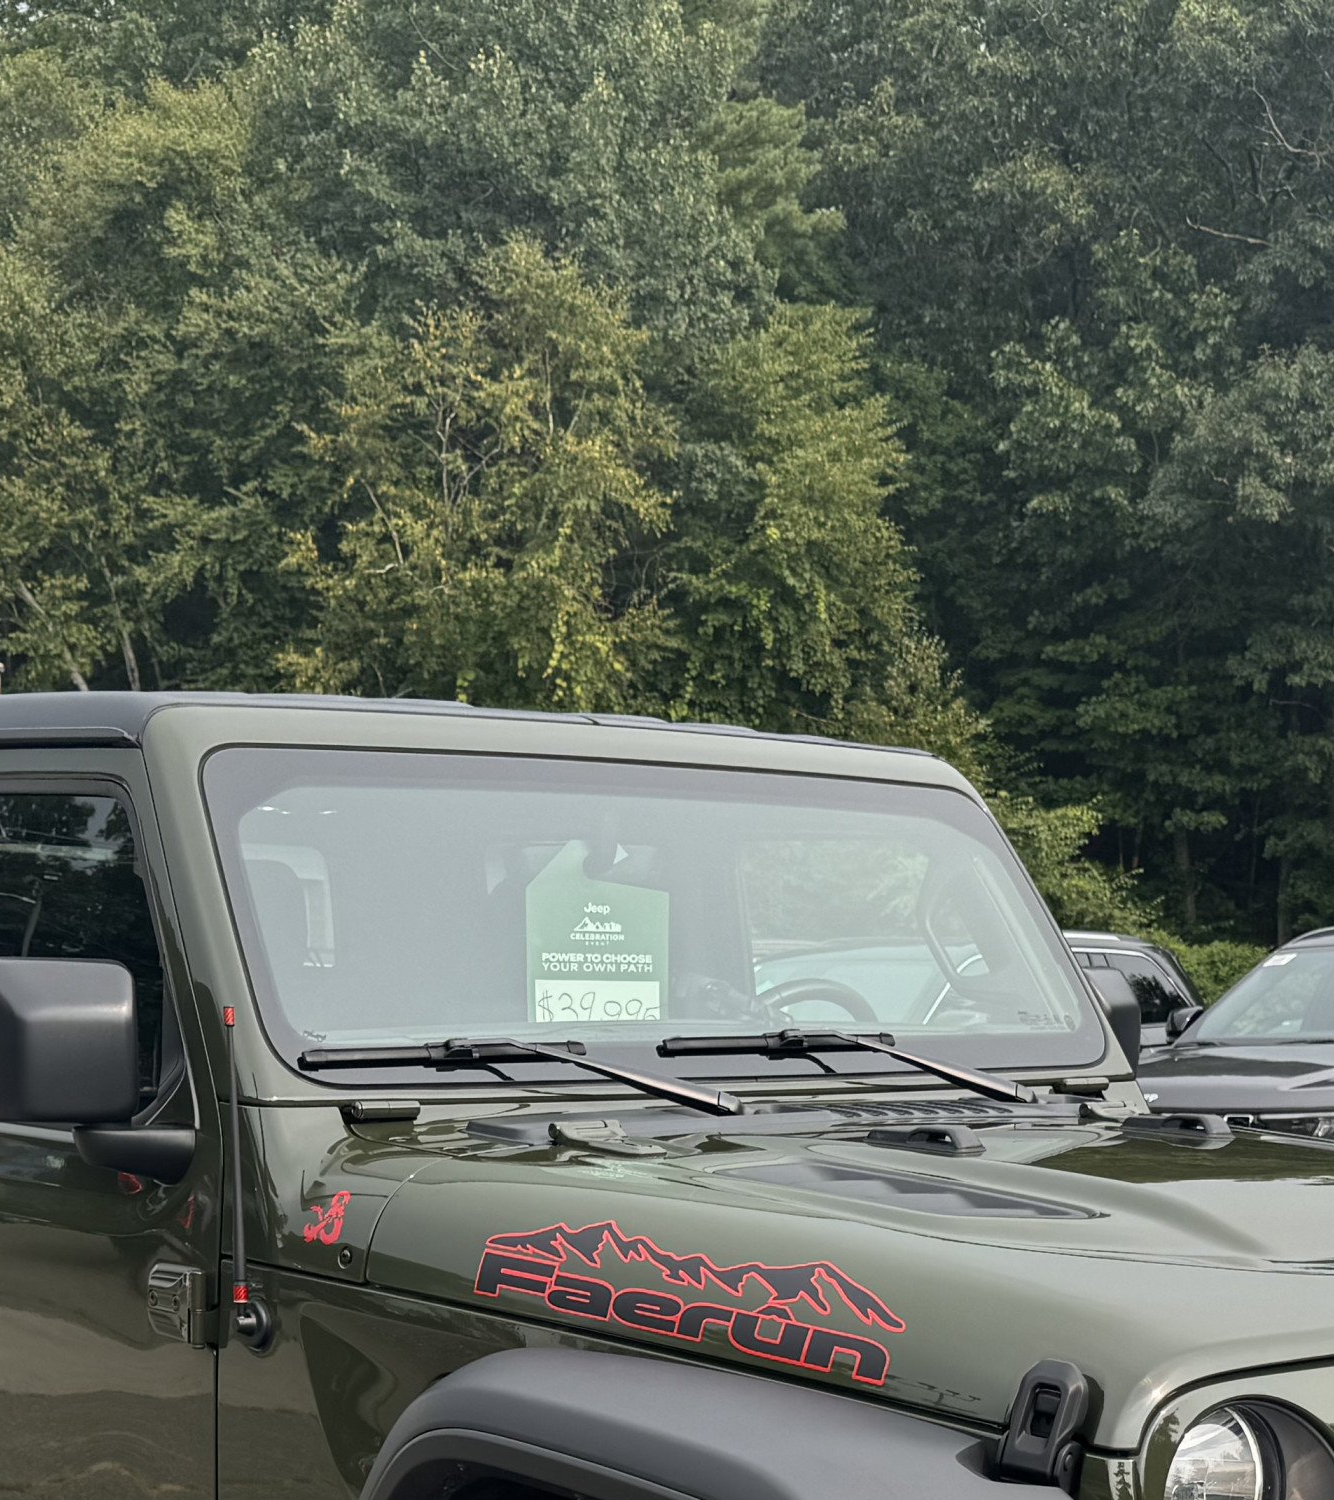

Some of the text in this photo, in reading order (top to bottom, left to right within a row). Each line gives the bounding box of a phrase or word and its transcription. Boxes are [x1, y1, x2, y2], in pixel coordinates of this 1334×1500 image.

[584, 902, 610, 915] Jeep
[570, 933, 624, 941] CELEBRATION
[541, 952, 653, 964] POWER TO CHOOSE
[541, 963, 653, 972] YOUR OWN PATH
